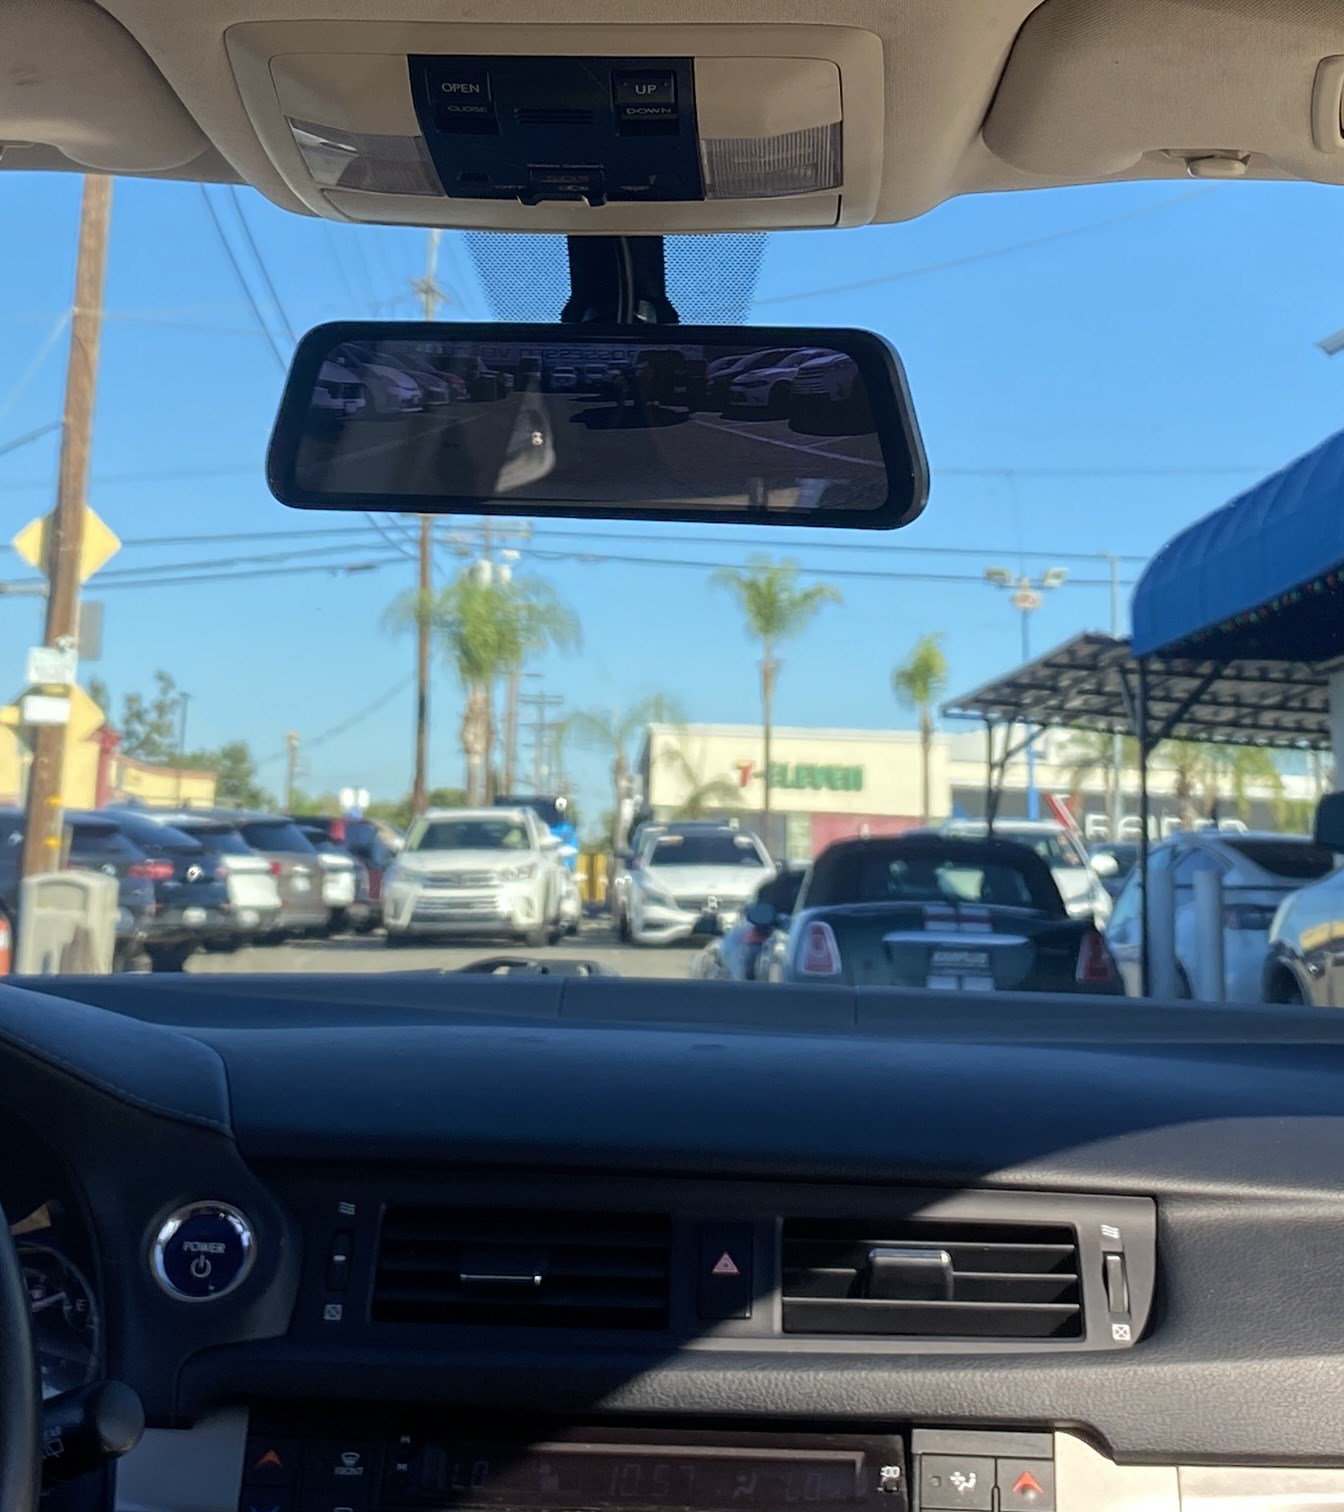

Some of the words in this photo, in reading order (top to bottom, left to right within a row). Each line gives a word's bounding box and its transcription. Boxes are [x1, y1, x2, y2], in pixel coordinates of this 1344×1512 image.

[441, 83, 481, 94] OPEN
[634, 84, 657, 95] UP
[626, 106, 672, 115] DOWN
[181, 1240, 226, 1255] POWER
